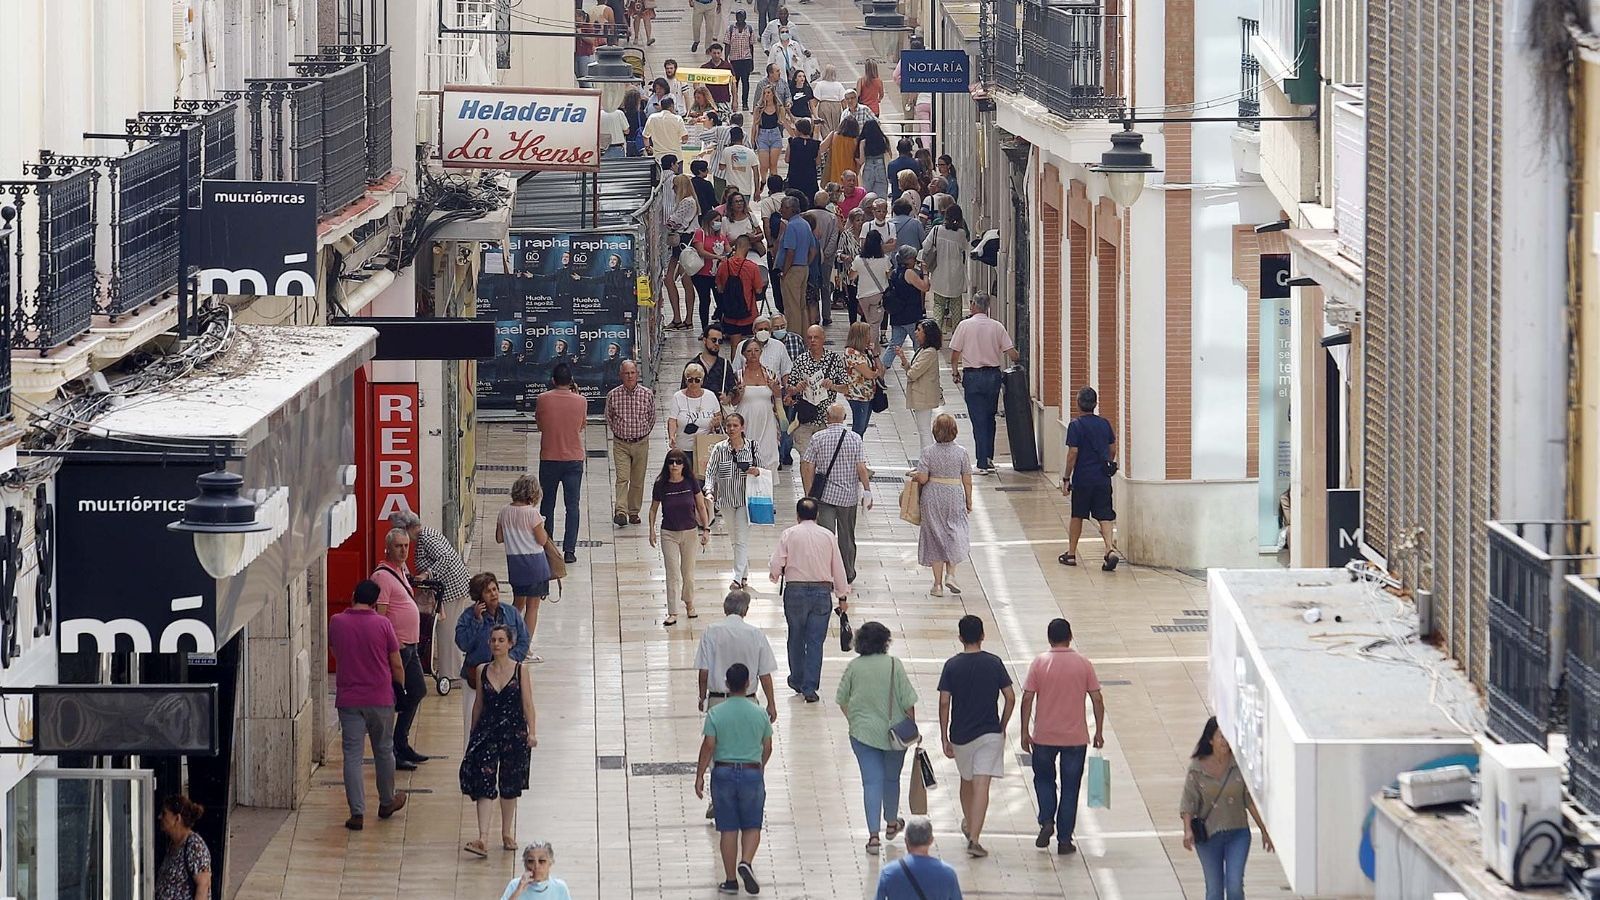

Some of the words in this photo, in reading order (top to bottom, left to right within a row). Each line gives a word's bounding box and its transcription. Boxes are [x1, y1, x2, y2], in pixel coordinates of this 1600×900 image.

[908, 60, 963, 72] NOTARÍA
[696, 75, 716, 83] ONCE
[458, 100, 587, 123] Heladeria
[447, 127, 493, 160] La
[525, 237, 570, 249] rapha
[573, 239, 632, 252] raphael
[1276, 269, 1289, 287] G
[1279, 308, 1290, 316] Se
[1279, 319, 1291, 327] ca
[525, 325, 577, 338] aphael
[579, 329, 630, 341] aphael
[1279, 351, 1291, 359] se
[1279, 361, 1291, 373] te
[1279, 375, 1291, 385] m
[377, 394, 414, 521] REBA
[78, 496, 186, 512] MULTIÓPTICA
[1339, 527, 1361, 549] M
